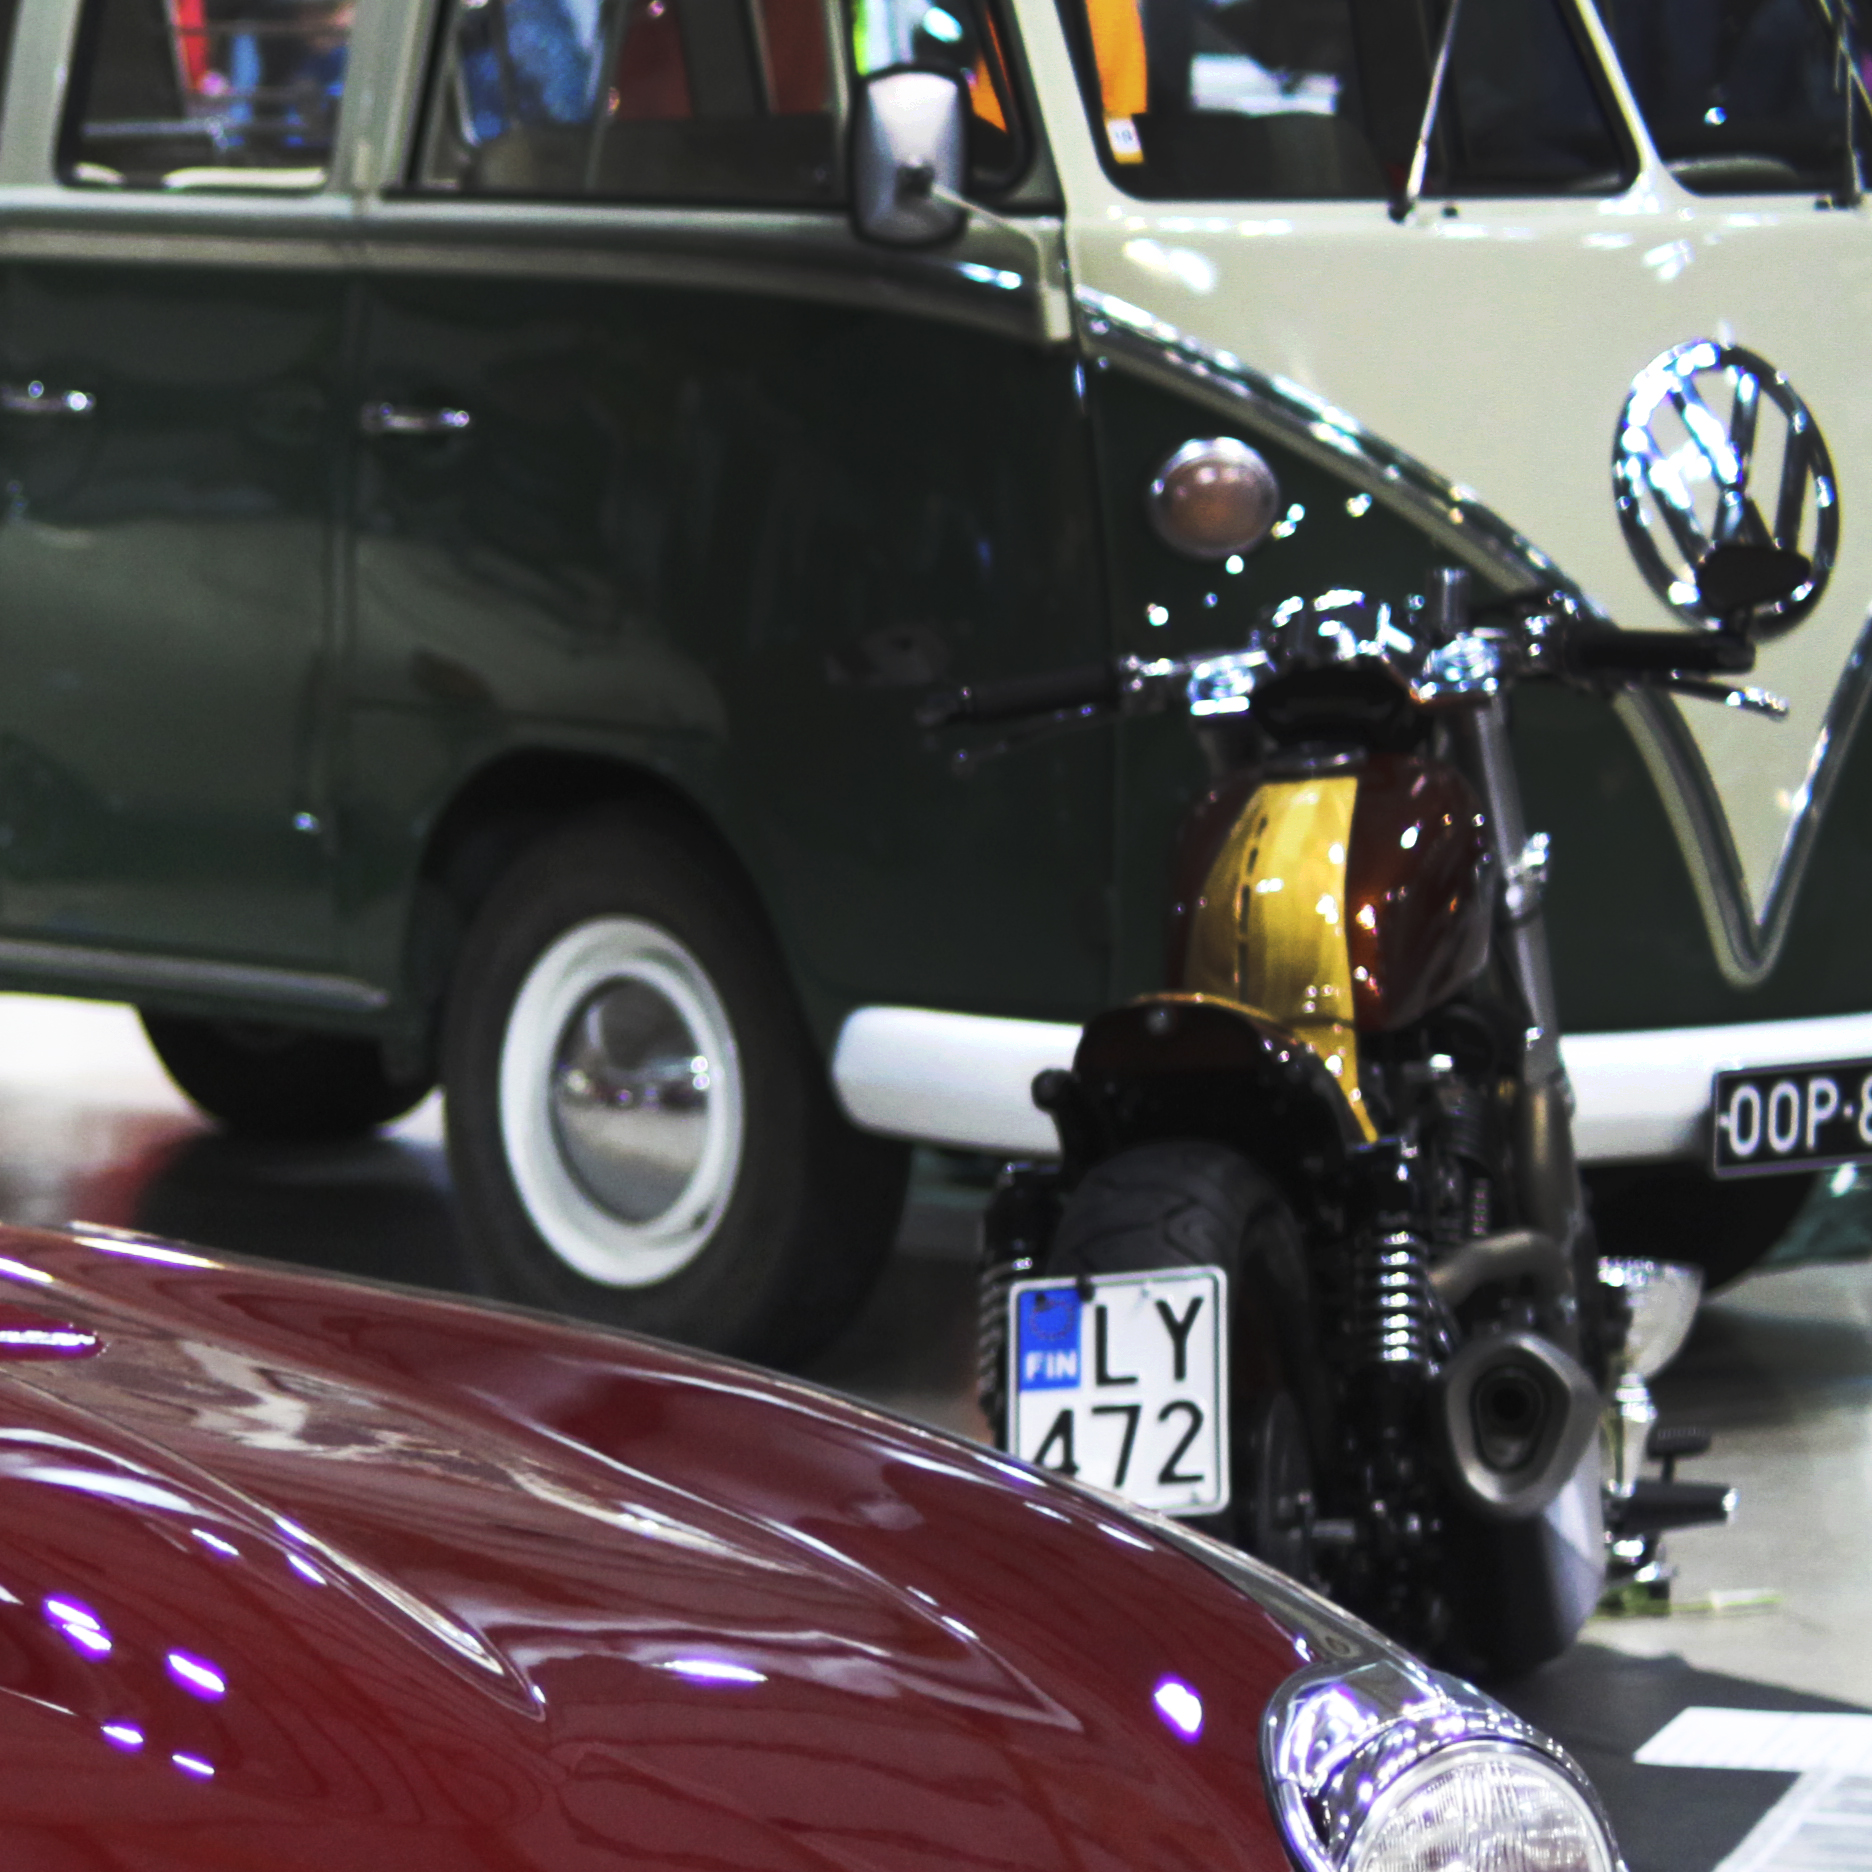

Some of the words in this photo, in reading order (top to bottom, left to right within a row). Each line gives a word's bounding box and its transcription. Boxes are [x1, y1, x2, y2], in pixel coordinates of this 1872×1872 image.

[1024, 1350, 1077, 1381] FIN
[1095, 1296, 1204, 1387] LY
[1034, 1399, 1205, 1487] 472
